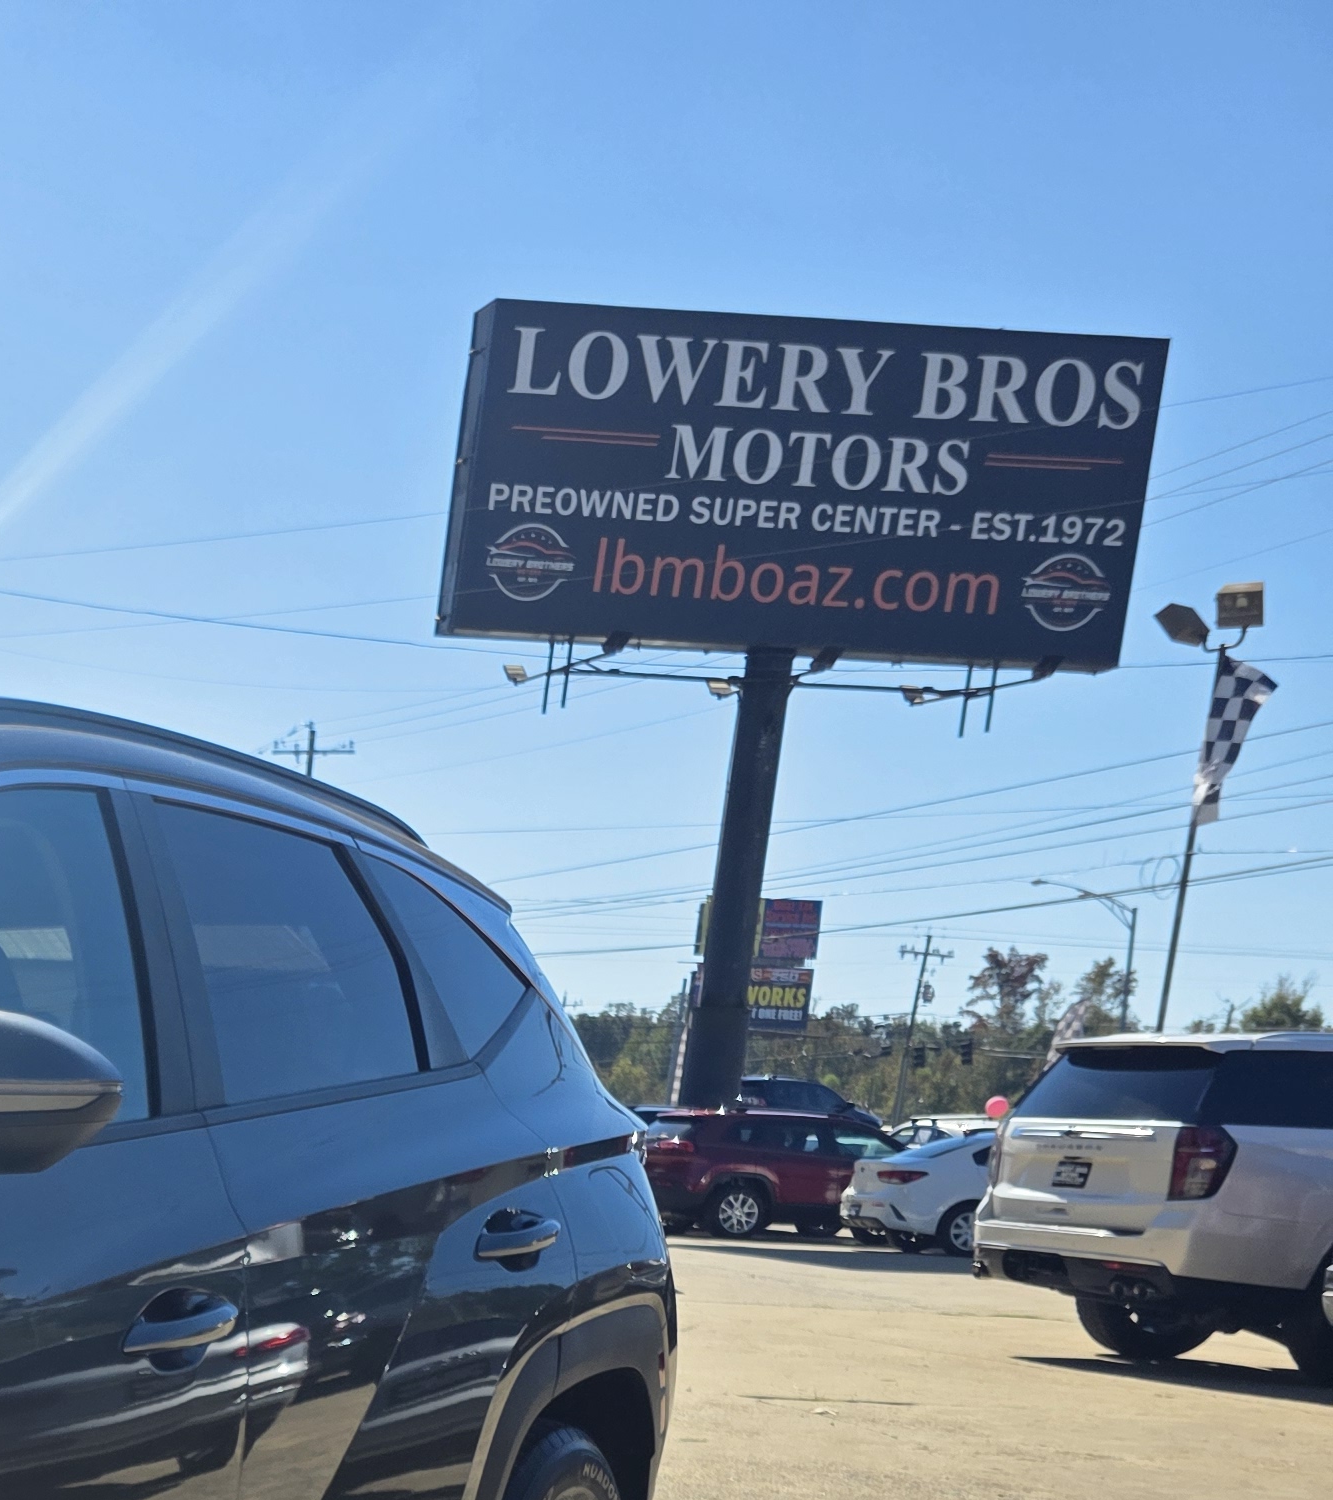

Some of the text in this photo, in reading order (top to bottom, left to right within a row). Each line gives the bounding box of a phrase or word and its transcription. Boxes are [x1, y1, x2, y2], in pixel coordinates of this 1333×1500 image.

[506, 325, 1144, 430] LOWERY BROS
[664, 423, 971, 496] MOTORS
[487, 482, 681, 523] PREOWNED
[688, 496, 802, 531] SUPER
[811, 503, 942, 538] CENTER
[970, 511, 1127, 548] EST.1972
[591, 536, 1001, 615] lbmboaz.com
